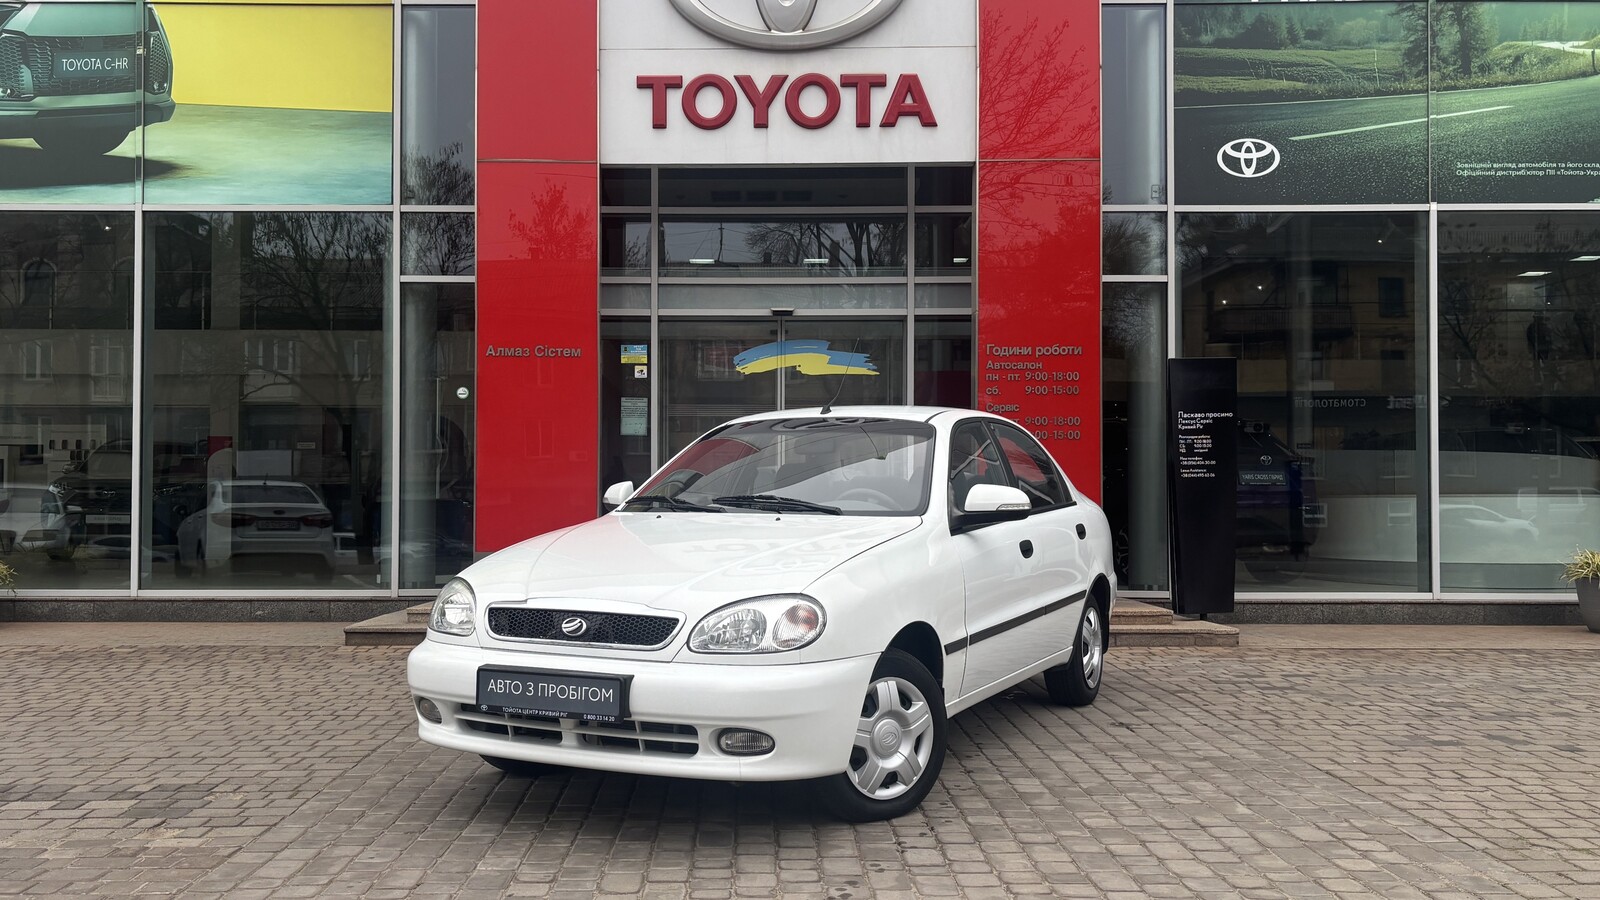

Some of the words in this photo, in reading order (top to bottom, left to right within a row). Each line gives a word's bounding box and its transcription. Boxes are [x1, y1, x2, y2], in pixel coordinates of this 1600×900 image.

[61, 58, 102, 71] TOYOTA
[104, 57, 129, 70] C-HR
[636, 72, 938, 131] TOYOTA
[1456, 169, 1495, 177] Офіційний
[485, 344, 530, 357] Алмаз
[534, 344, 582, 357] Сістем
[986, 343, 1032, 357] Години
[1035, 343, 1083, 358] роботи
[986, 360, 1043, 370] Автосалон
[986, 385, 1002, 395] сб.
[986, 402, 1020, 413] Сервіс
[487, 678, 523, 695] АВТО
[526, 681, 534, 696] З
[538, 683, 614, 703] ПРОБІГОМ
[502, 706, 522, 714] ТОЙОТА
